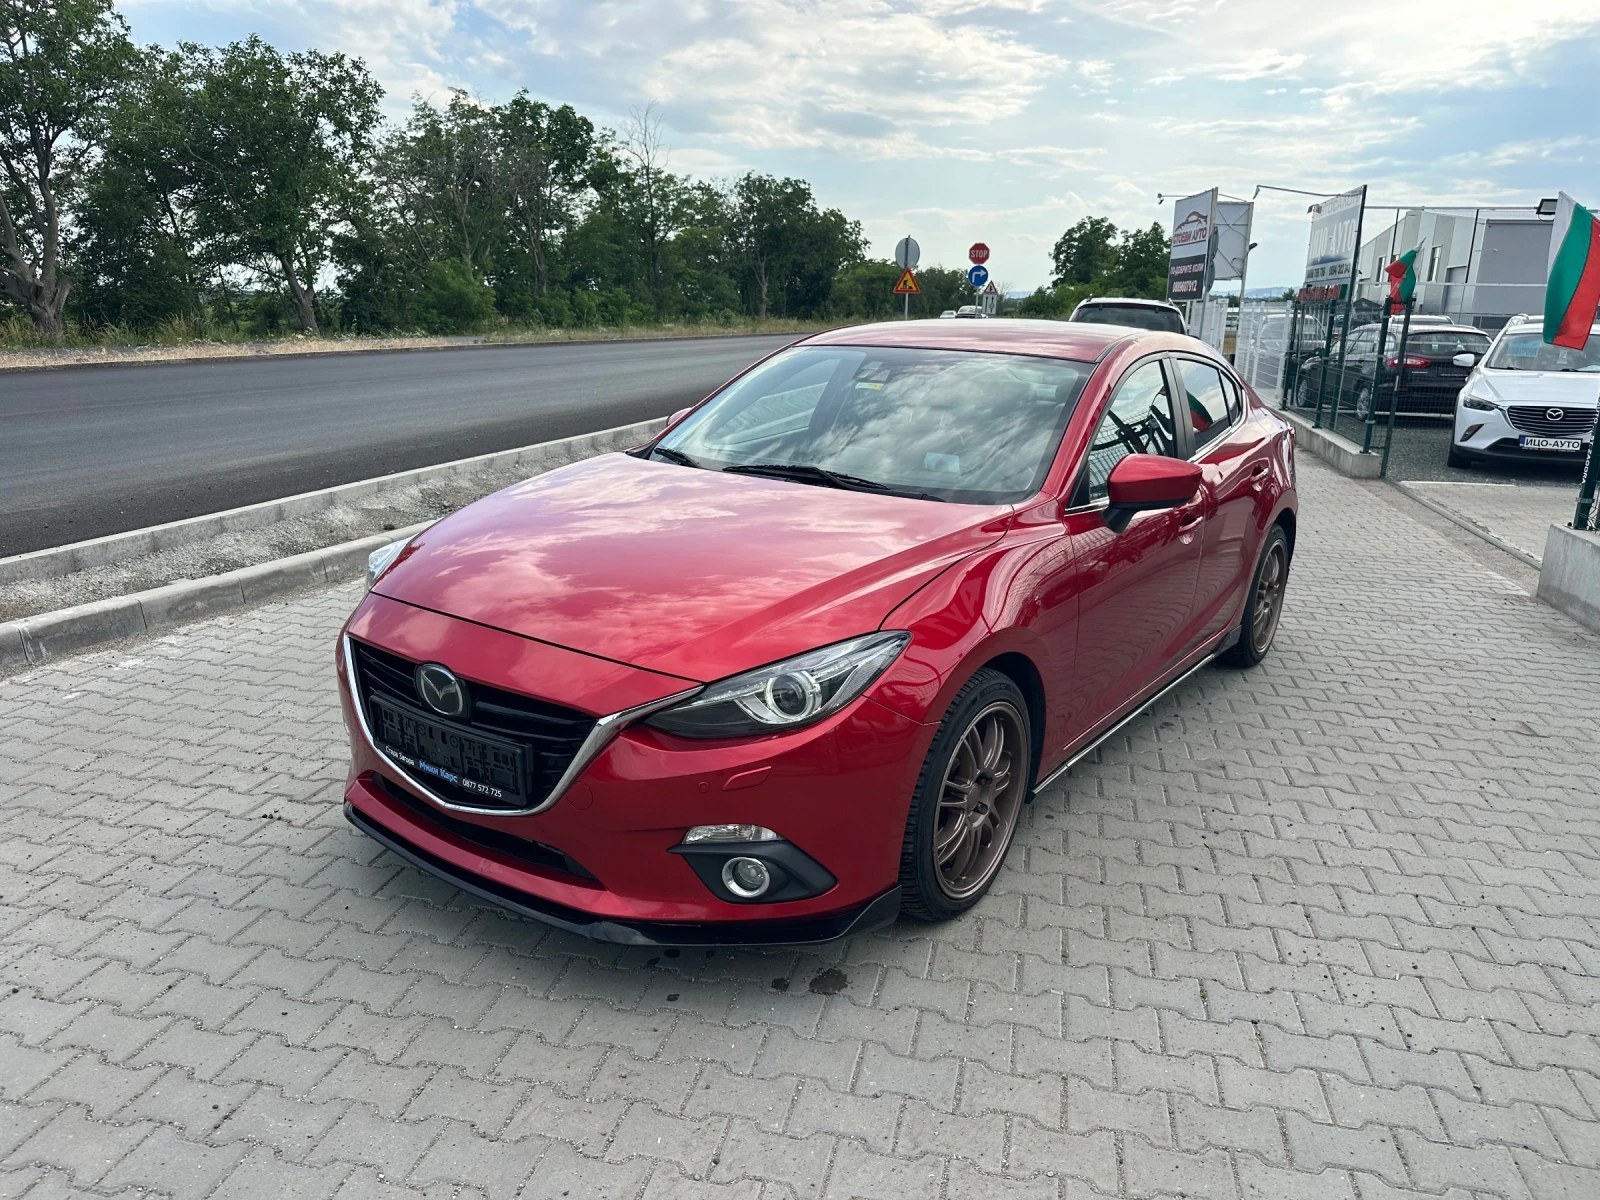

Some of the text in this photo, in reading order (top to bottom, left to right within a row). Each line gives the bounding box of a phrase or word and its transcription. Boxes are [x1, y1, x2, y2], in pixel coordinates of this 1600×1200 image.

[1173, 226, 1208, 245] СТОЕВИ АУТО
[971, 249, 988, 258] STOP
[1525, 438, 1580, 449] ИЦО-АУТО
[1581, 449, 1593, 484] ZAGORA
[385, 745, 399, 758] Стара
[398, 752, 415, 766] Загора
[462, 778, 477, 789] 0877
[477, 784, 489, 794] 572
[490, 788, 502, 798] 725
